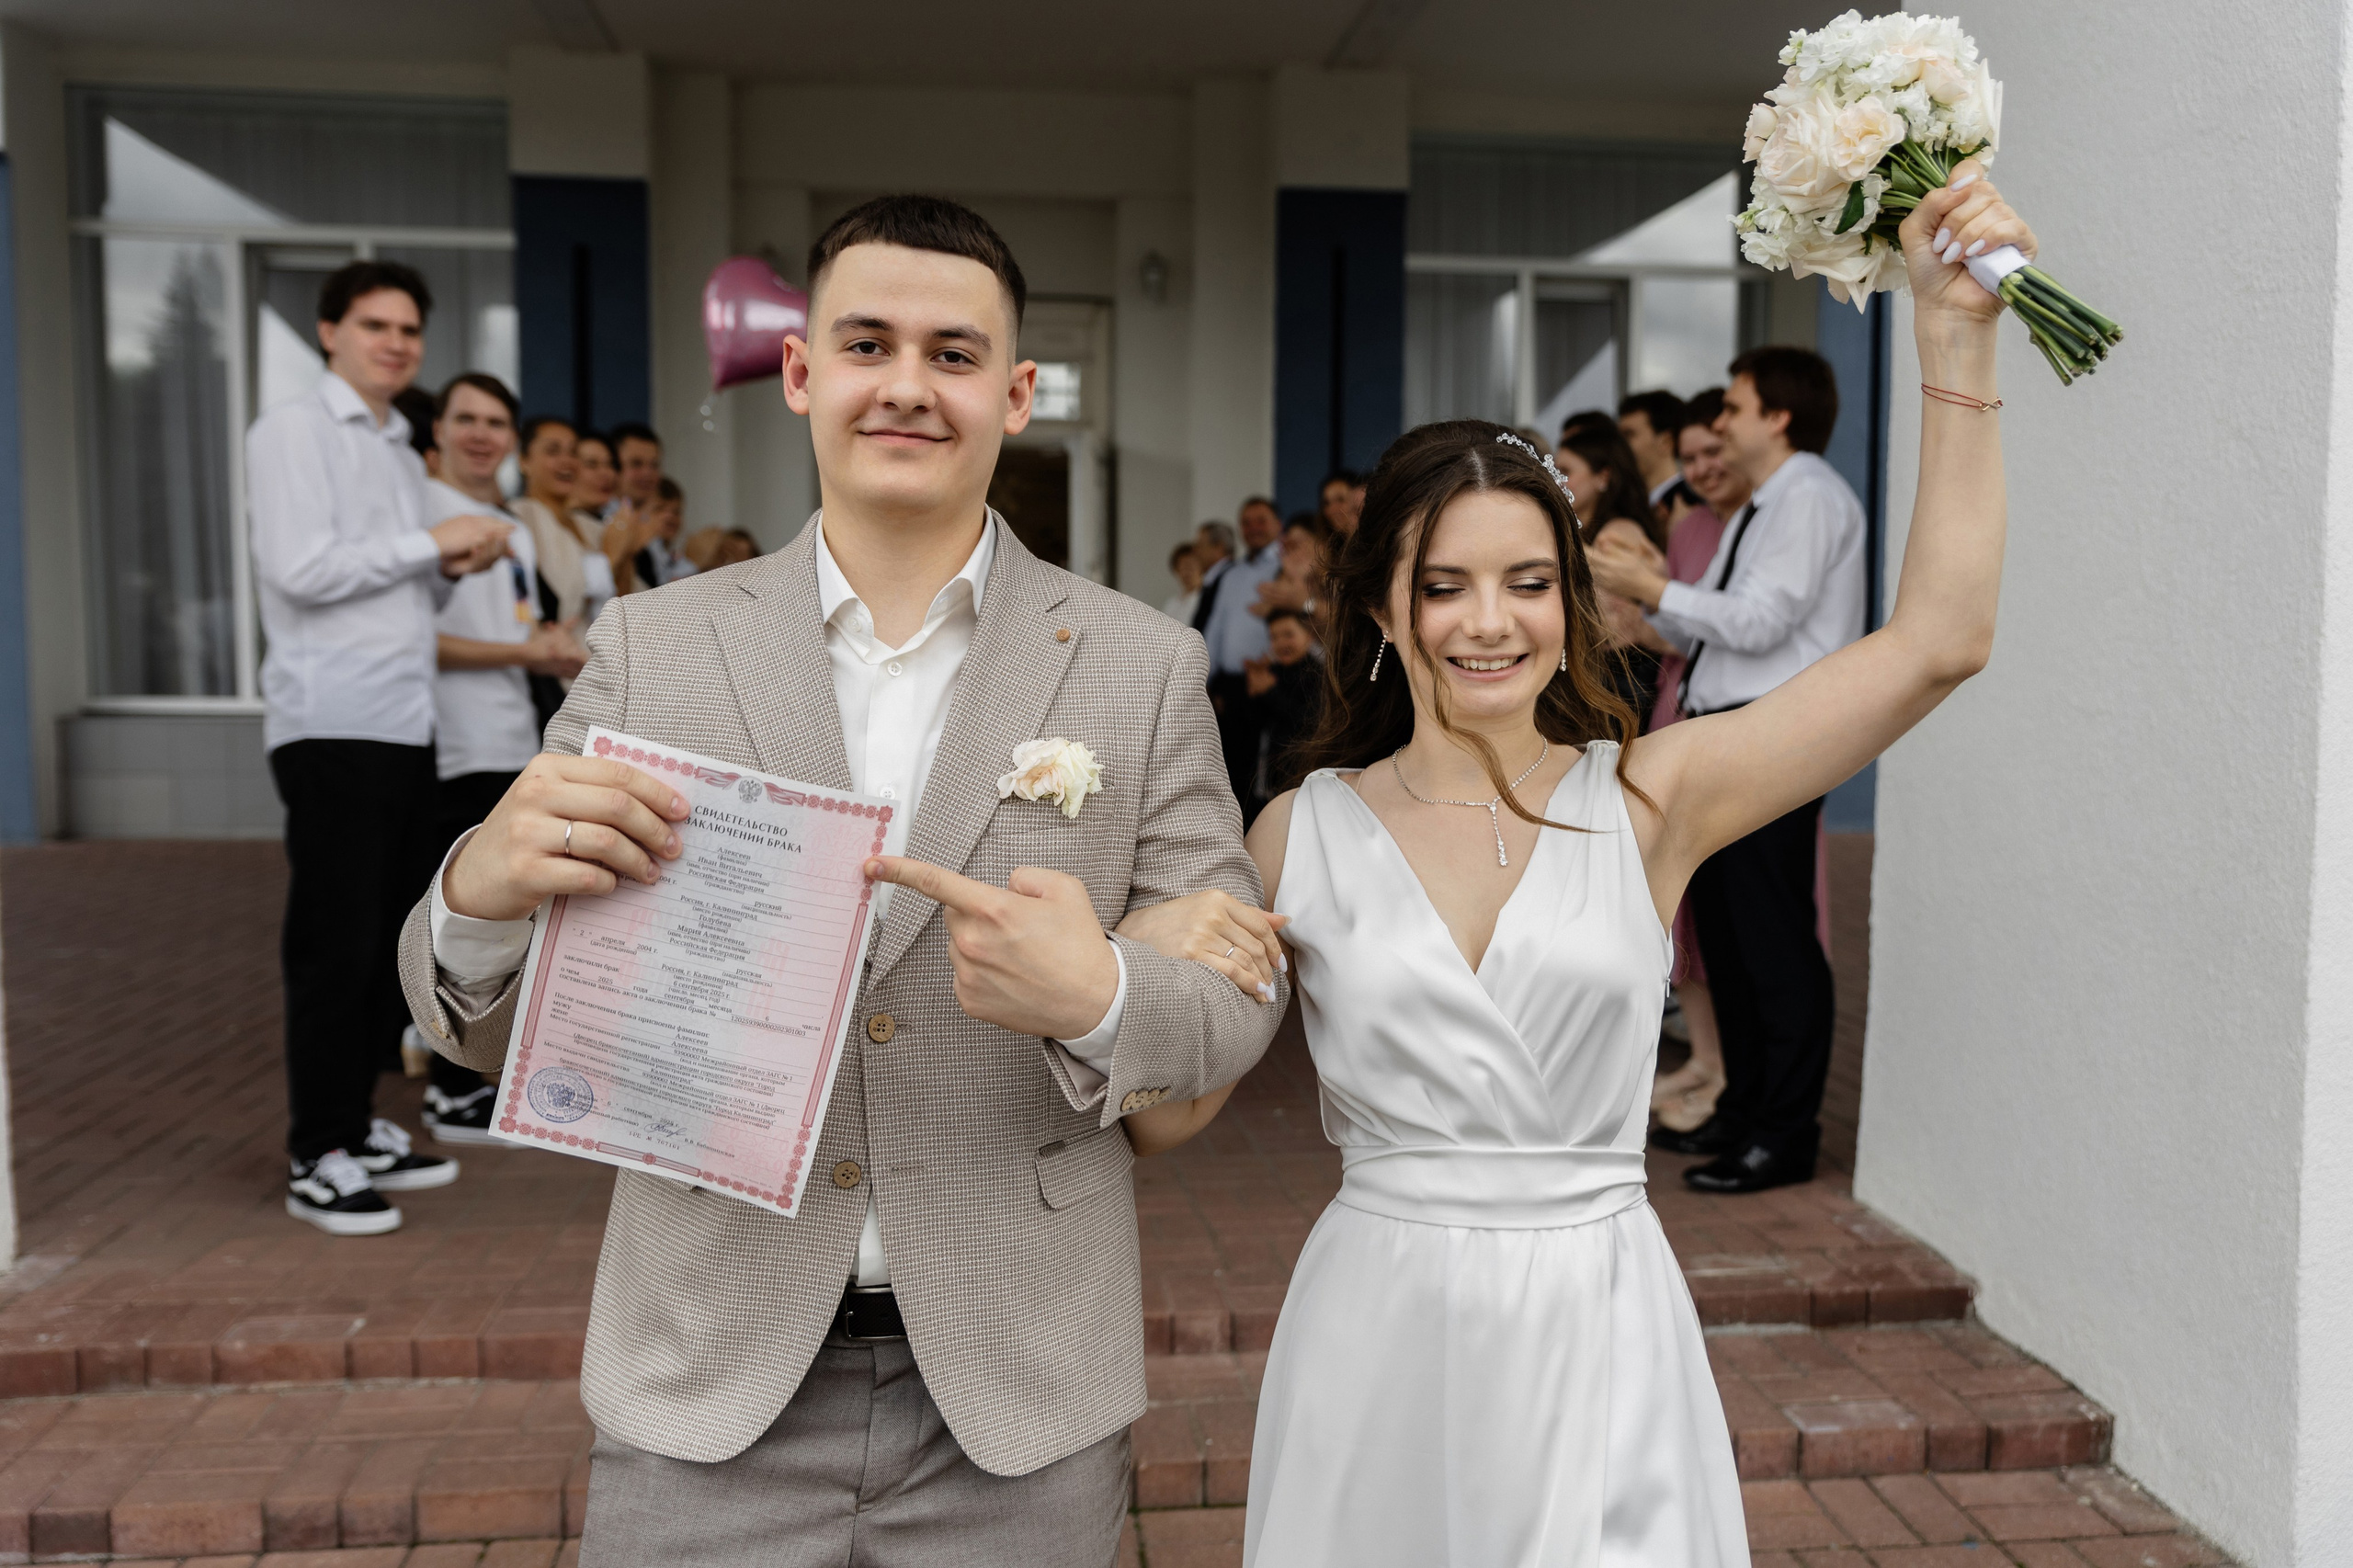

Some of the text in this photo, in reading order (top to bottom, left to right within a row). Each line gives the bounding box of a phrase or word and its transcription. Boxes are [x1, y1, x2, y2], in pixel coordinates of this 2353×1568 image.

[693, 804, 788, 837] СВИДЕТЕЛЬСТВО
[683, 816, 803, 854] ЗАКЛЮЧЕНИИ БРАКА
[716, 846, 751, 860] Алексеев
[716, 854, 747, 866] (фамилия)
[697, 856, 763, 878] Иван Витальевич
[701, 865, 728, 876] отчество
[728, 872, 742, 881] (при
[657, 874, 671, 883] 004
[754, 899, 782, 912] русский
[687, 868, 765, 894] Российская Федерация
[704, 880, 745, 895] (гражданство)
[679, 895, 705, 907] Россия,
[711, 903, 758, 920] Калининград
[692, 905, 742, 923] (место рождения)
[741, 904, 792, 920] (национальность)
[698, 914, 732, 929] Голубева
[698, 922, 728, 934] (фамилия)
[676, 924, 745, 946] Мария Алексеевна
[682, 933, 708, 944] отчество
[600, 935, 625, 947] апреля
[636, 943, 652, 952] 2004
[736, 968, 762, 980] русская
[669, 937, 745, 962] Российская Федерация
[685, 948, 725, 963] (гражданство)
[563, 953, 603, 968] заключили
[602, 963, 620, 973] брак
[677, 981, 708, 995] сентября
[709, 988, 725, 997] 2025
[590, 939, 772, 988] (дата рождения) (национальность)
[660, 963, 686, 975] Россия,
[692, 971, 739, 988] Калининград
[673, 973, 723, 990] (место рождения)
[558, 973, 596, 988] составлена
[597, 984, 621, 994] запись
[622, 990, 638, 998] акта
[644, 995, 687, 1011] заключении
[687, 1005, 707, 1016] брака
[597, 976, 613, 984] 2025
[632, 985, 648, 994] года
[663, 993, 694, 1006] сентября
[708, 1003, 732, 1015] месяца
[801, 1023, 821, 1032] числа
[552, 1000, 708, 1046] мужу Алексеев
[554, 992, 574, 1002] После
[574, 999, 616, 1014] заключения
[616, 1010, 637, 1021] брака
[637, 1016, 675, 1031] присвоены
[551, 1007, 708, 1054] жене Алексеева
[549, 1013, 568, 1023] Место
[568, 1019, 620, 1039] государственной
[620, 1035, 660, 1051] регистрации
[700, 1056, 747, 1072] Межрайонный
[747, 1066, 765, 1076] отдел
[765, 1070, 781, 1079] ЗАГС
[572, 1032, 598, 1044] (Дворец
[700, 1068, 733, 1082] городского
[734, 1076, 754, 1087] округа
[755, 1081, 775, 1092] "Город
[543, 1041, 562, 1051] Место
[562, 1047, 586, 1059] выдачи
[668, 1079, 714, 1096] Межрайонный
[715, 1092, 732, 1101] отдел
[732, 1096, 747, 1105] ЗАГС
[760, 1103, 785, 1115] (Дворец
[760, 1075, 785, 1087] которым
[658, 1089, 692, 1103] городского
[691, 1099, 713, 1109] округа
